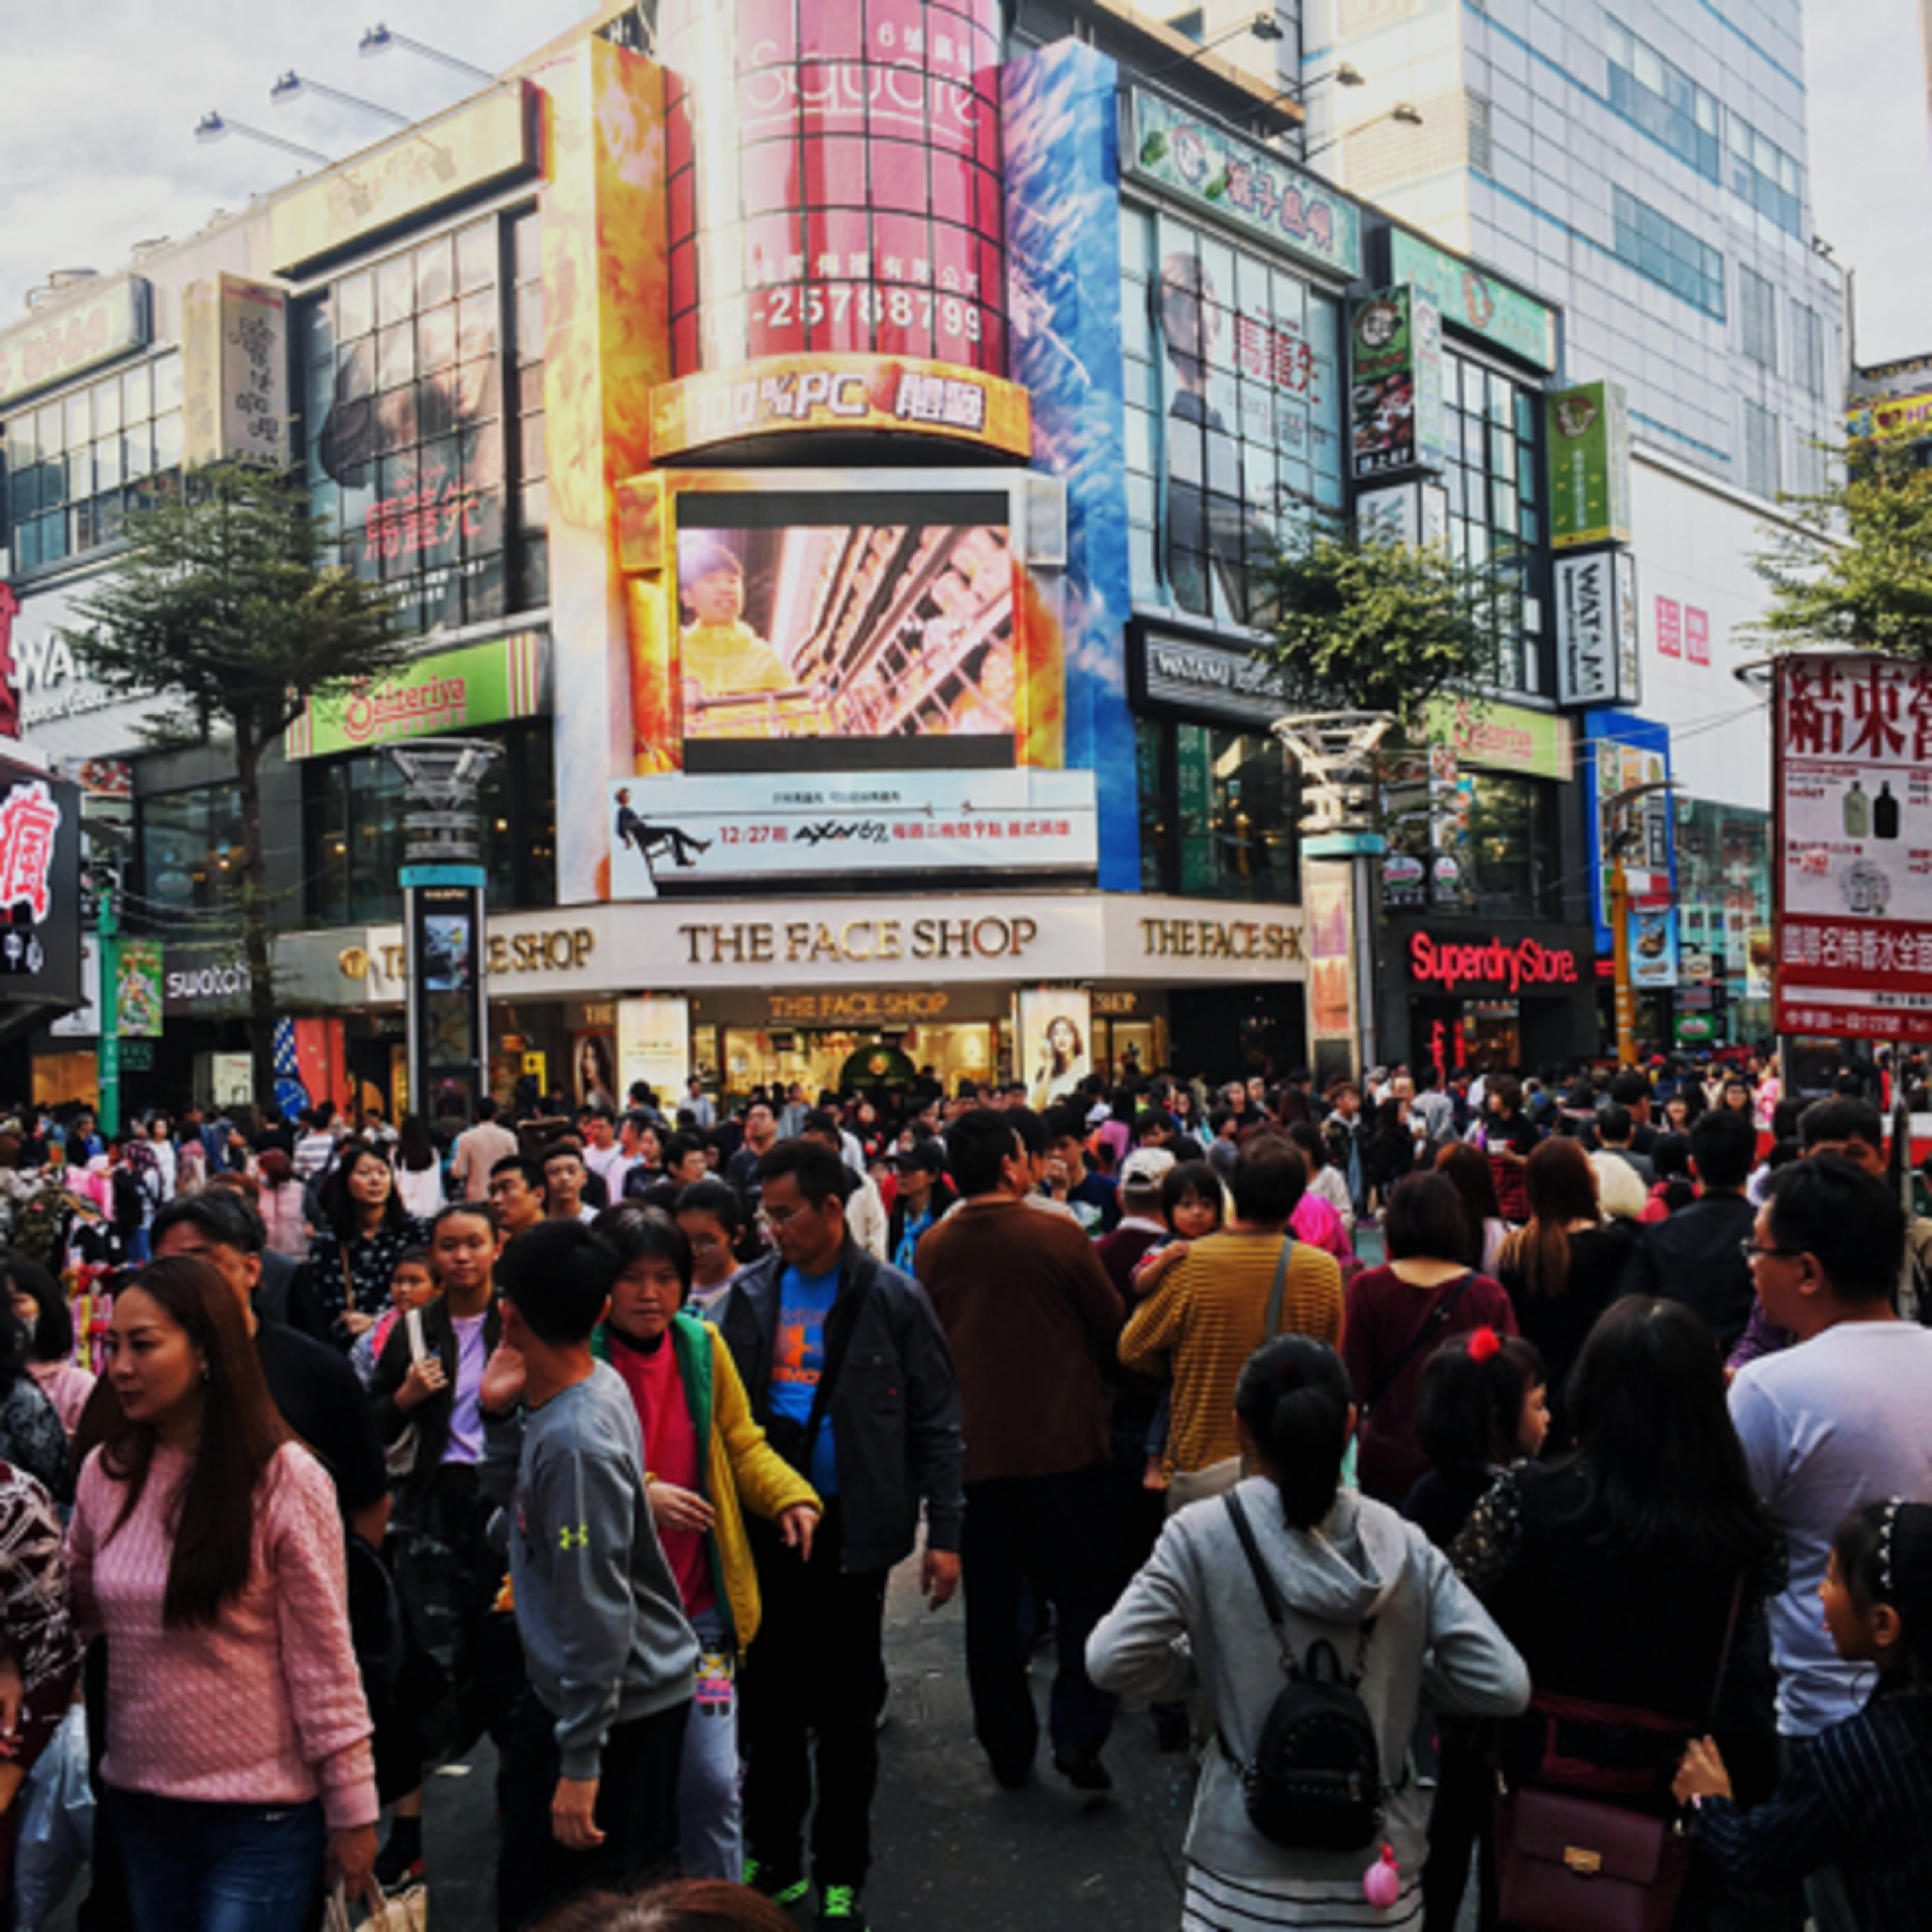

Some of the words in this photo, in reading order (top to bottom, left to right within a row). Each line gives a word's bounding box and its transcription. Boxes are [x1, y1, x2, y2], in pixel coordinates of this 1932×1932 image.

[511, 927, 595, 972] SHOP
[679, 923, 773, 963] THE
[785, 920, 903, 961] FACE
[911, 916, 1038, 960] SHOP
[1410, 930, 1519, 994] Superdry
[168, 962, 251, 998] swatch
[768, 994, 816, 1018] THE
[820, 992, 878, 1017] FACE
[883, 990, 948, 1016] SHOP
